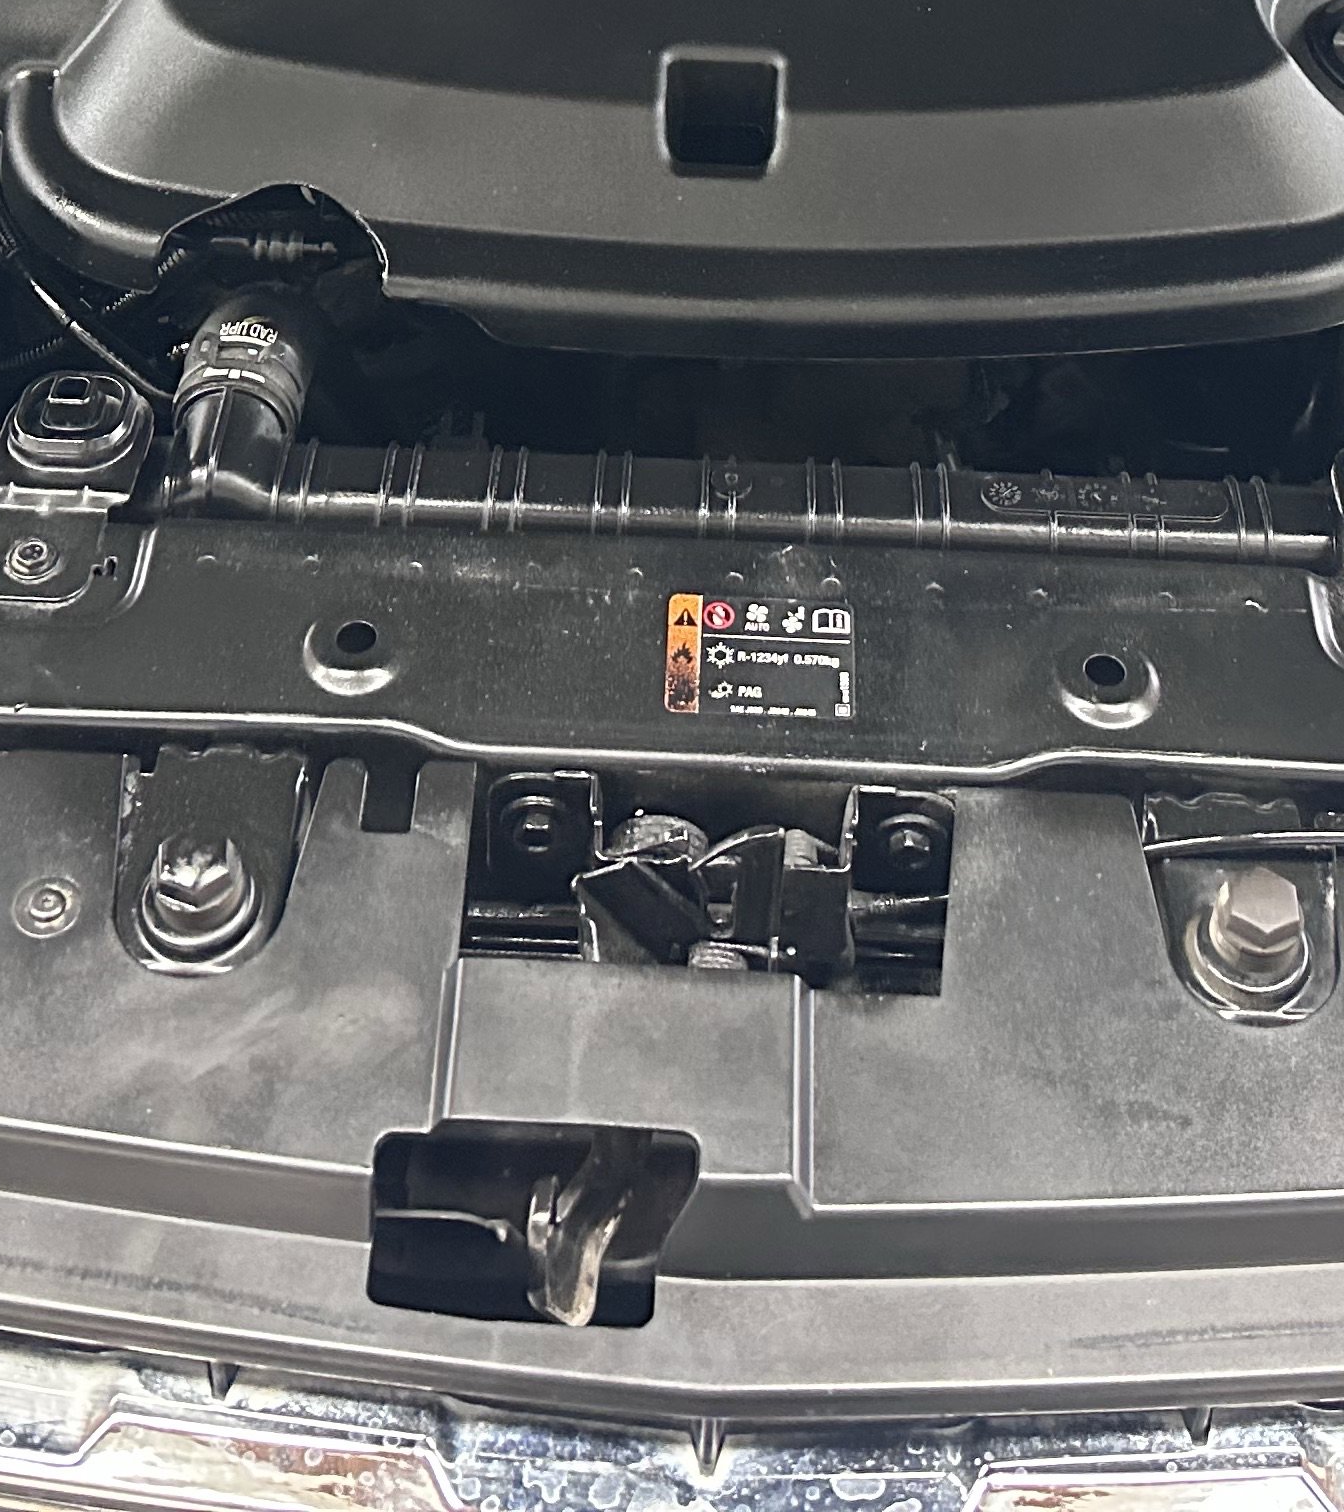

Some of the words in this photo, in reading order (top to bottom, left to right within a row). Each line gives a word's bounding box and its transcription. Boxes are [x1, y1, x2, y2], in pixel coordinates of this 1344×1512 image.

[219, 321, 249, 336] UPR
[250, 323, 278, 344] RAD
[744, 622, 770, 632] AUTO
[737, 686, 763, 699] PAG
